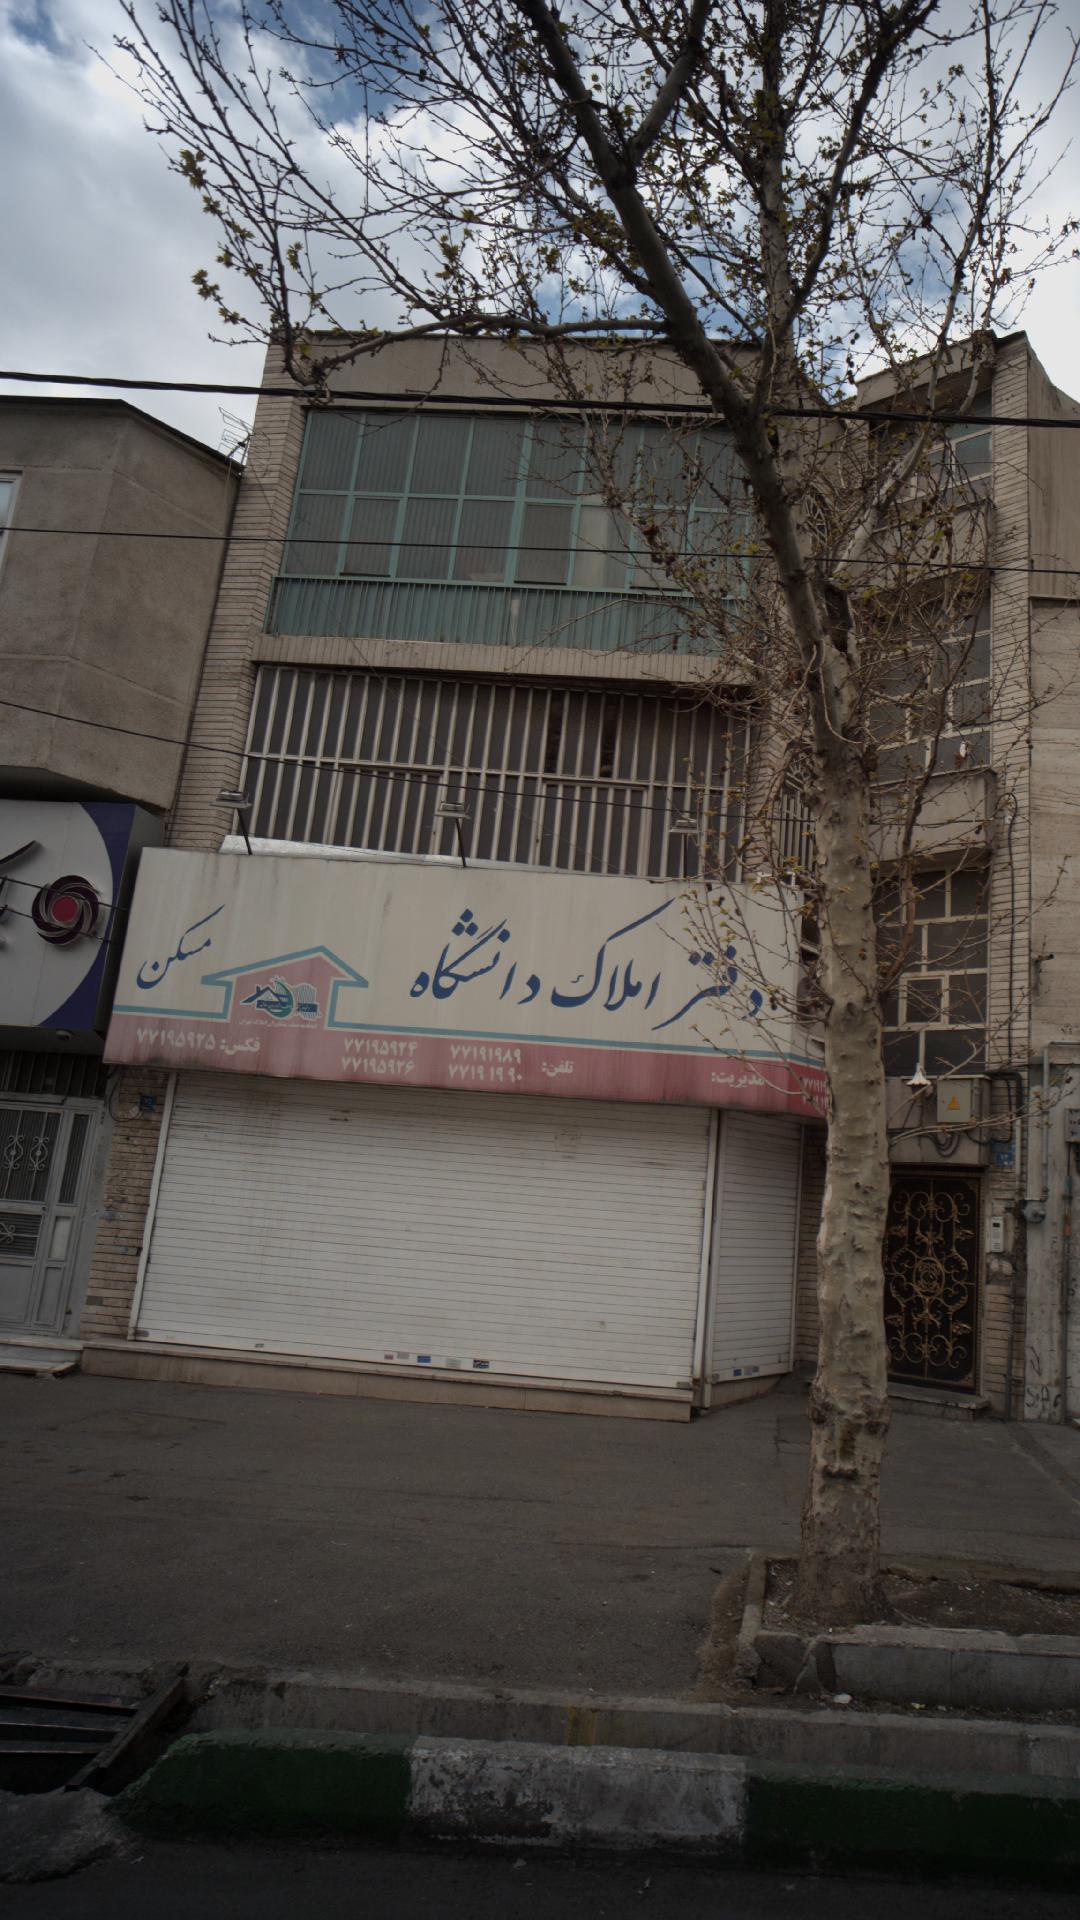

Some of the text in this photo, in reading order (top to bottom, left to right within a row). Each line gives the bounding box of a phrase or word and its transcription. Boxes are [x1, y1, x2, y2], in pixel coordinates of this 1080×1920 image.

[136, 904, 226, 989] مسکن
[410, 908, 541, 1005] دانشگاه
[651, 945, 764, 1030] دفتر
